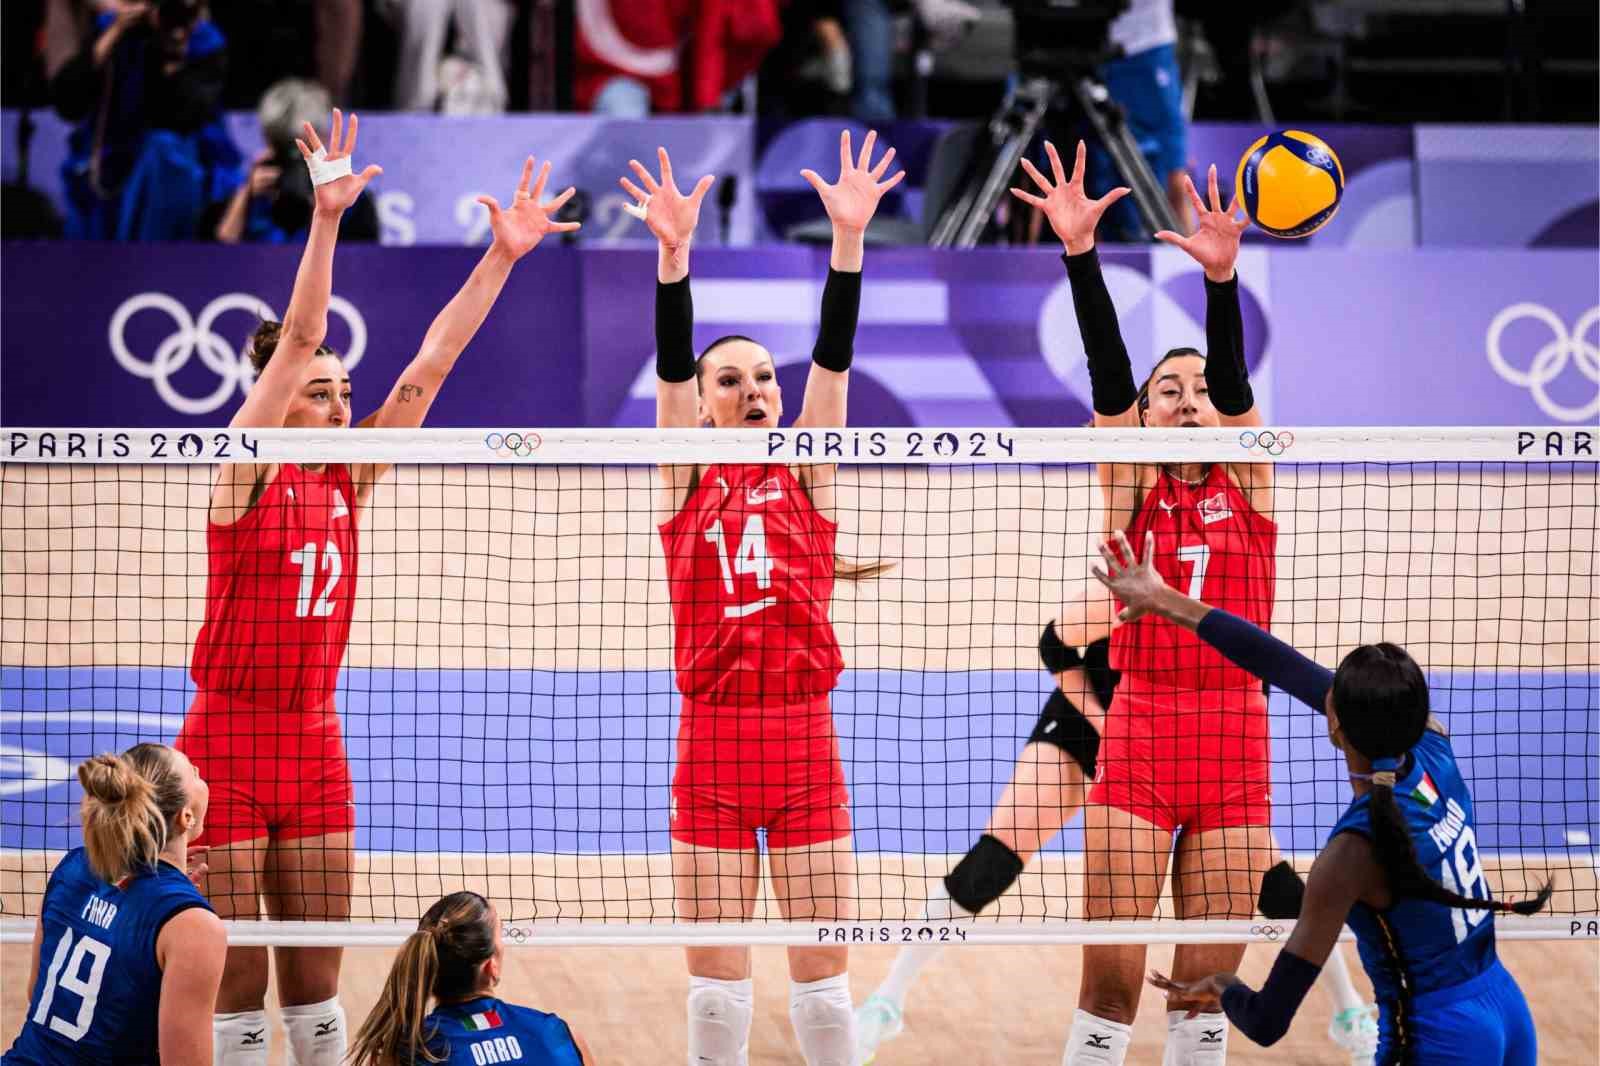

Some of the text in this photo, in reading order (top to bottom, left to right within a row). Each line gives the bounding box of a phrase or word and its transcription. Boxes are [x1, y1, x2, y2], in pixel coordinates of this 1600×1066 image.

[149, 432, 259, 458] 2024
[906, 432, 1014, 457] 2024
[1517, 431, 1593, 456] PAR
[703, 513, 775, 595] 14
[289, 540, 343, 618] 12
[1177, 544, 1211, 601] 7
[1441, 825, 1490, 945] 18
[901, 926, 967, 943] 2024
[1570, 920, 1598, 936] PA
[32, 926, 113, 1042] 19
[469, 1035, 523, 1066] ORRO
